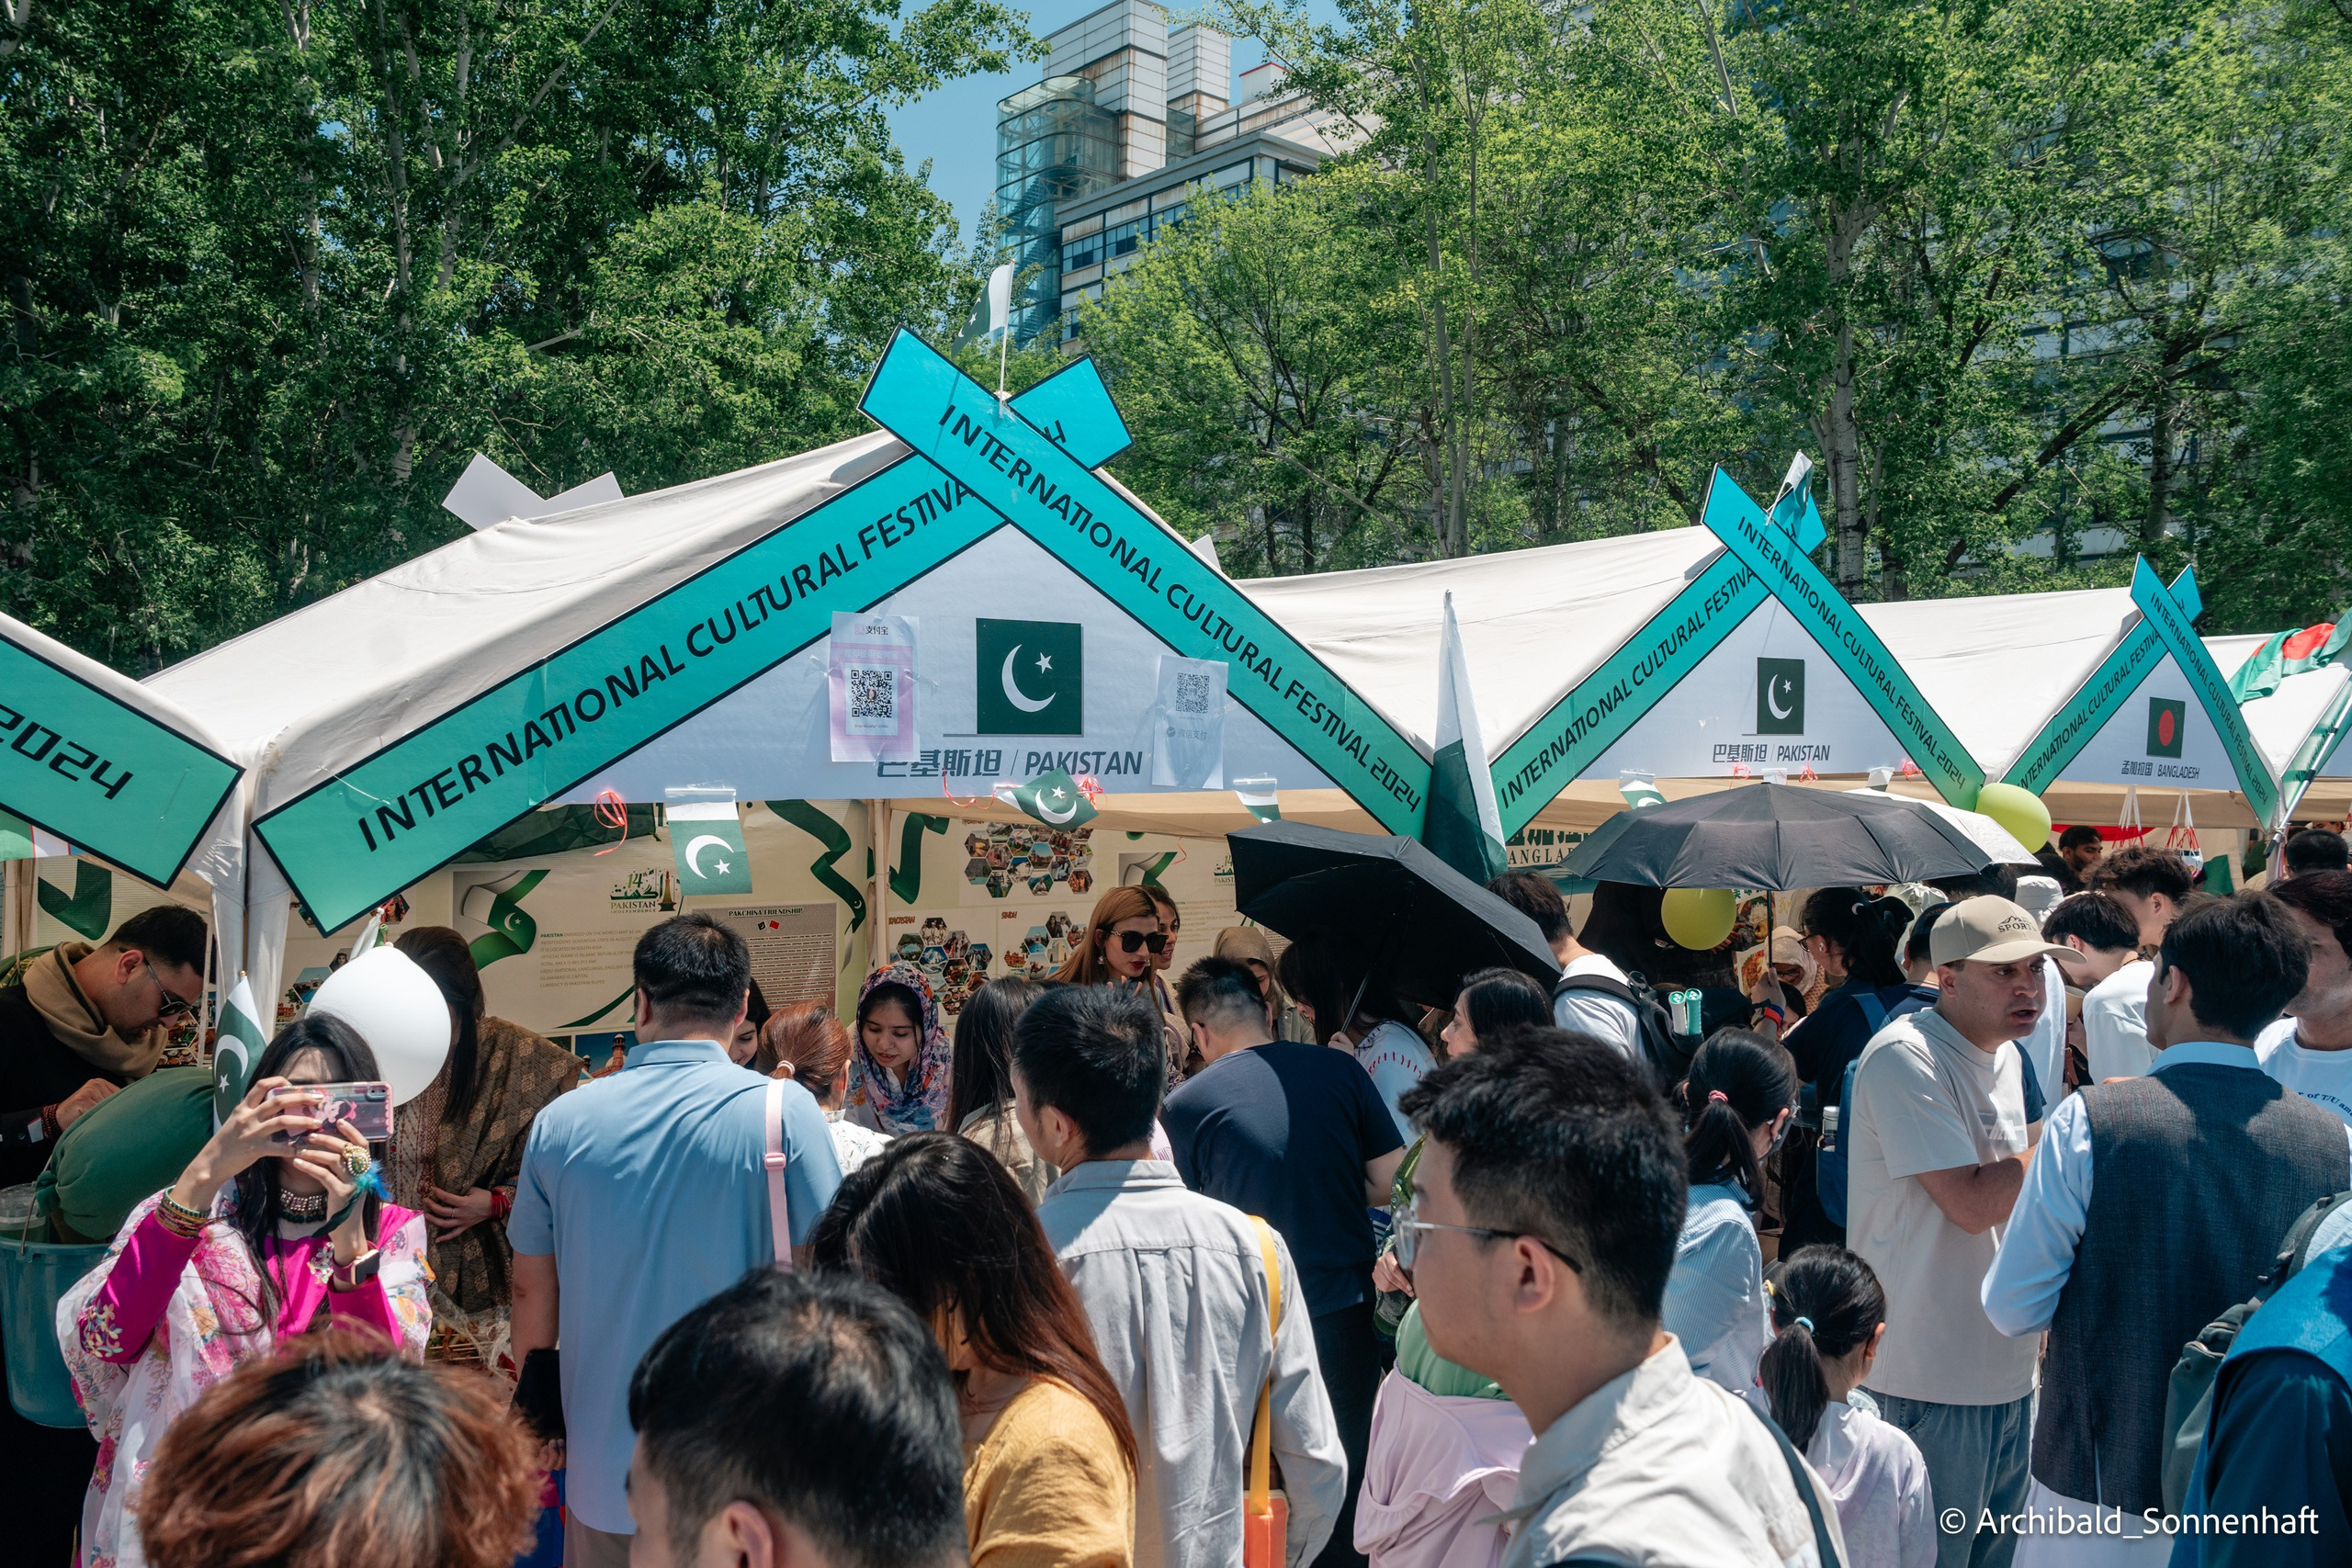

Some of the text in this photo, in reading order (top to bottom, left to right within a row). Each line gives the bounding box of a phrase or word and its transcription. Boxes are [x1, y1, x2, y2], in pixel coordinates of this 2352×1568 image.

[865, 625, 888, 636] 支付宝
[938, 404, 1422, 814] INTERNATIONAL CULTURAL FESTIVAL 2024
[357, 479, 971, 852] INTERNATIONAL CULTURAL FESTIVA
[1737, 516, 1966, 790] INTERNATIONAL CULTURAL FESTIVAL 2024
[2088, 660, 2132, 716] CULTURAL
[2130, 629, 2160, 671] FESTIVA
[1500, 566, 1757, 809] INTERNATIONAL CULTURAL FESTIVA
[2150, 592, 2269, 806] INTERNATIONAL CULTURAL FESTIVAL 2024
[1024, 750, 1143, 776] PAKISTAN
[1713, 744, 1830, 762] 巴基斯坦 PAKISTAN
[2121, 760, 2200, 780] 孟加拉国 BANGLADESH
[610, 900, 656, 909] PAKISTAN
[763, 908, 803, 916] FRIENDSHIP
